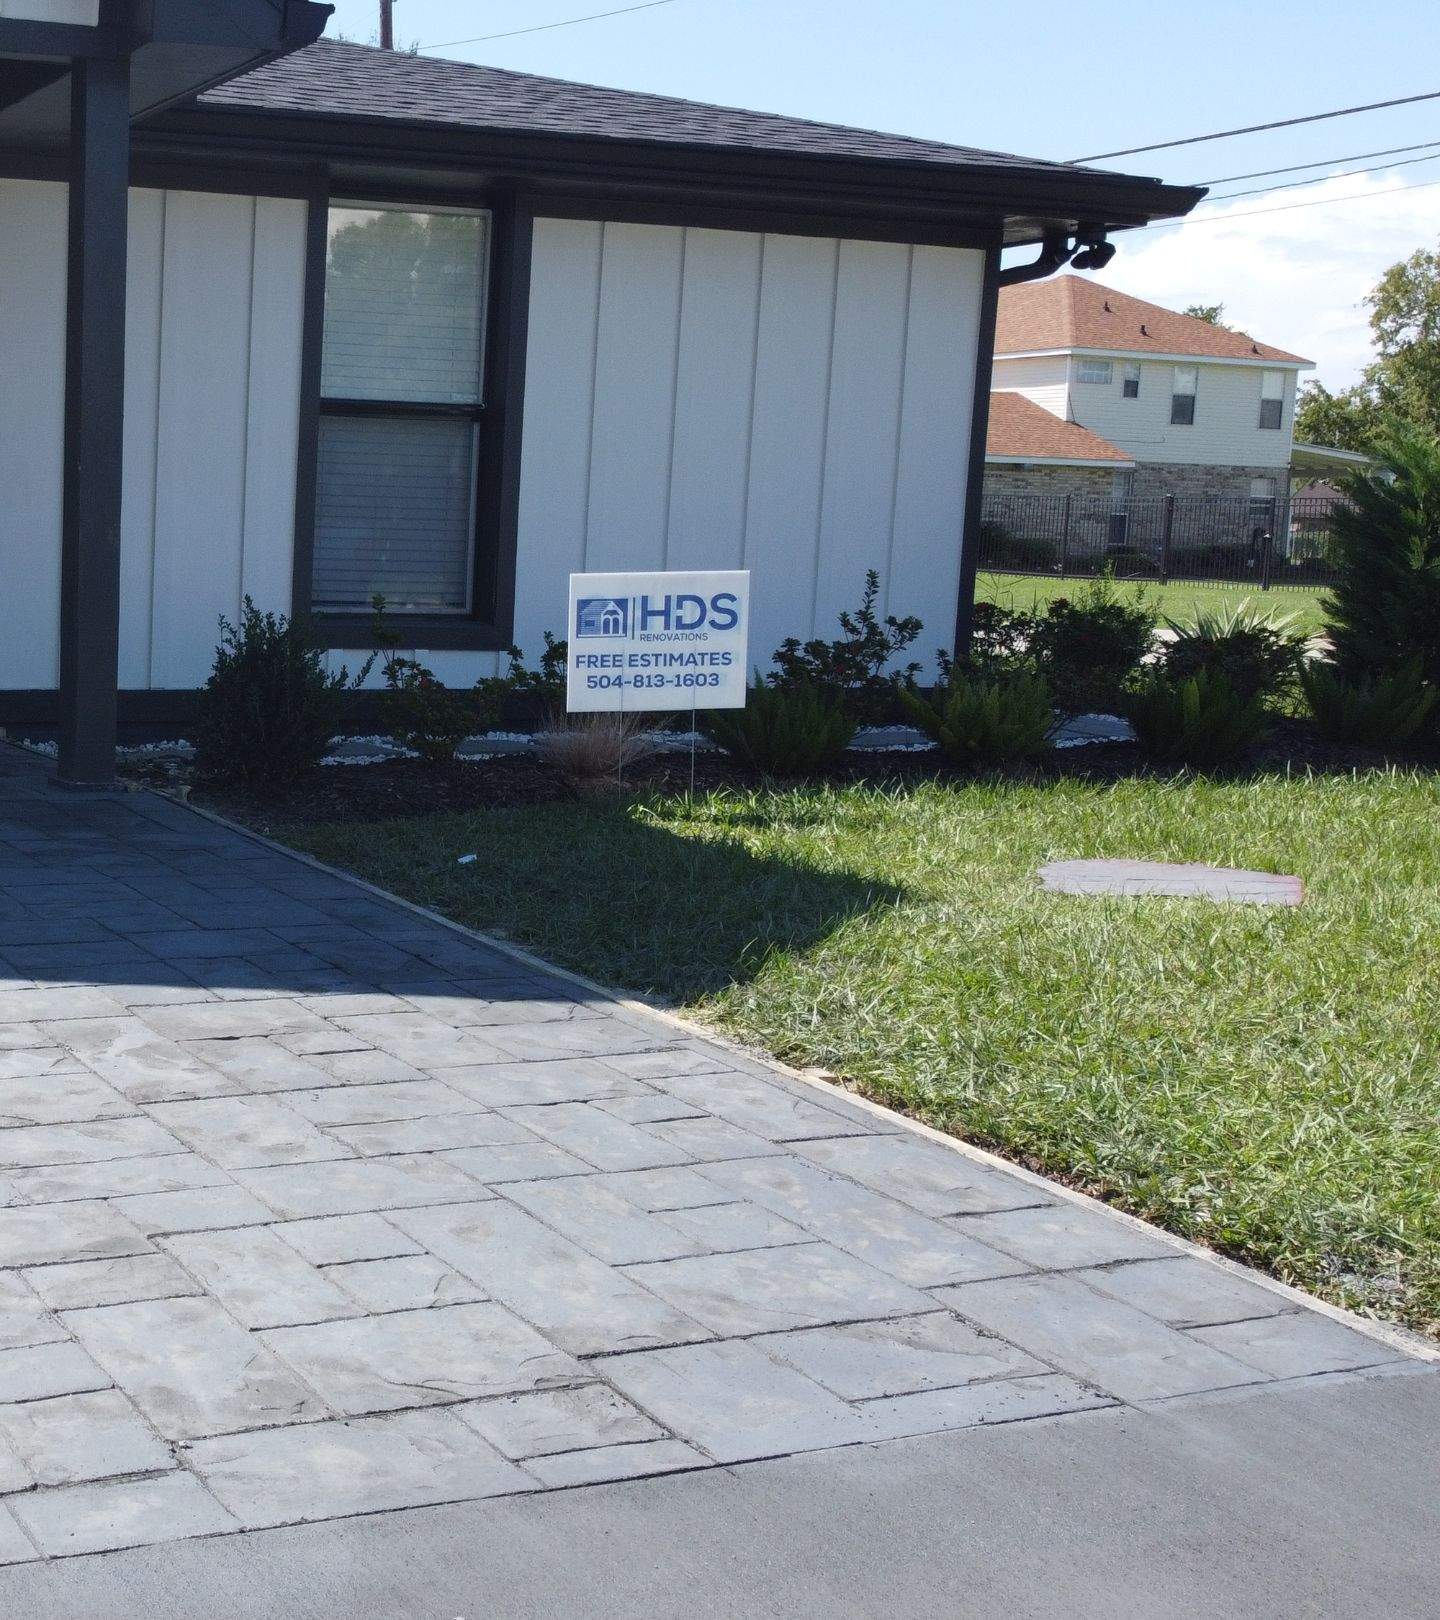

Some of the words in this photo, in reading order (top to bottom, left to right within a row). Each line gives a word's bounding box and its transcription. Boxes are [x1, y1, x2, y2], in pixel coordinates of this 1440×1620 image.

[640, 592, 739, 631] HDS
[640, 632, 709, 642] RENOVATIONS
[575, 654, 623, 668] FREE
[628, 652, 732, 667] ESTIMATES
[586, 673, 720, 689] 504-813-1603
